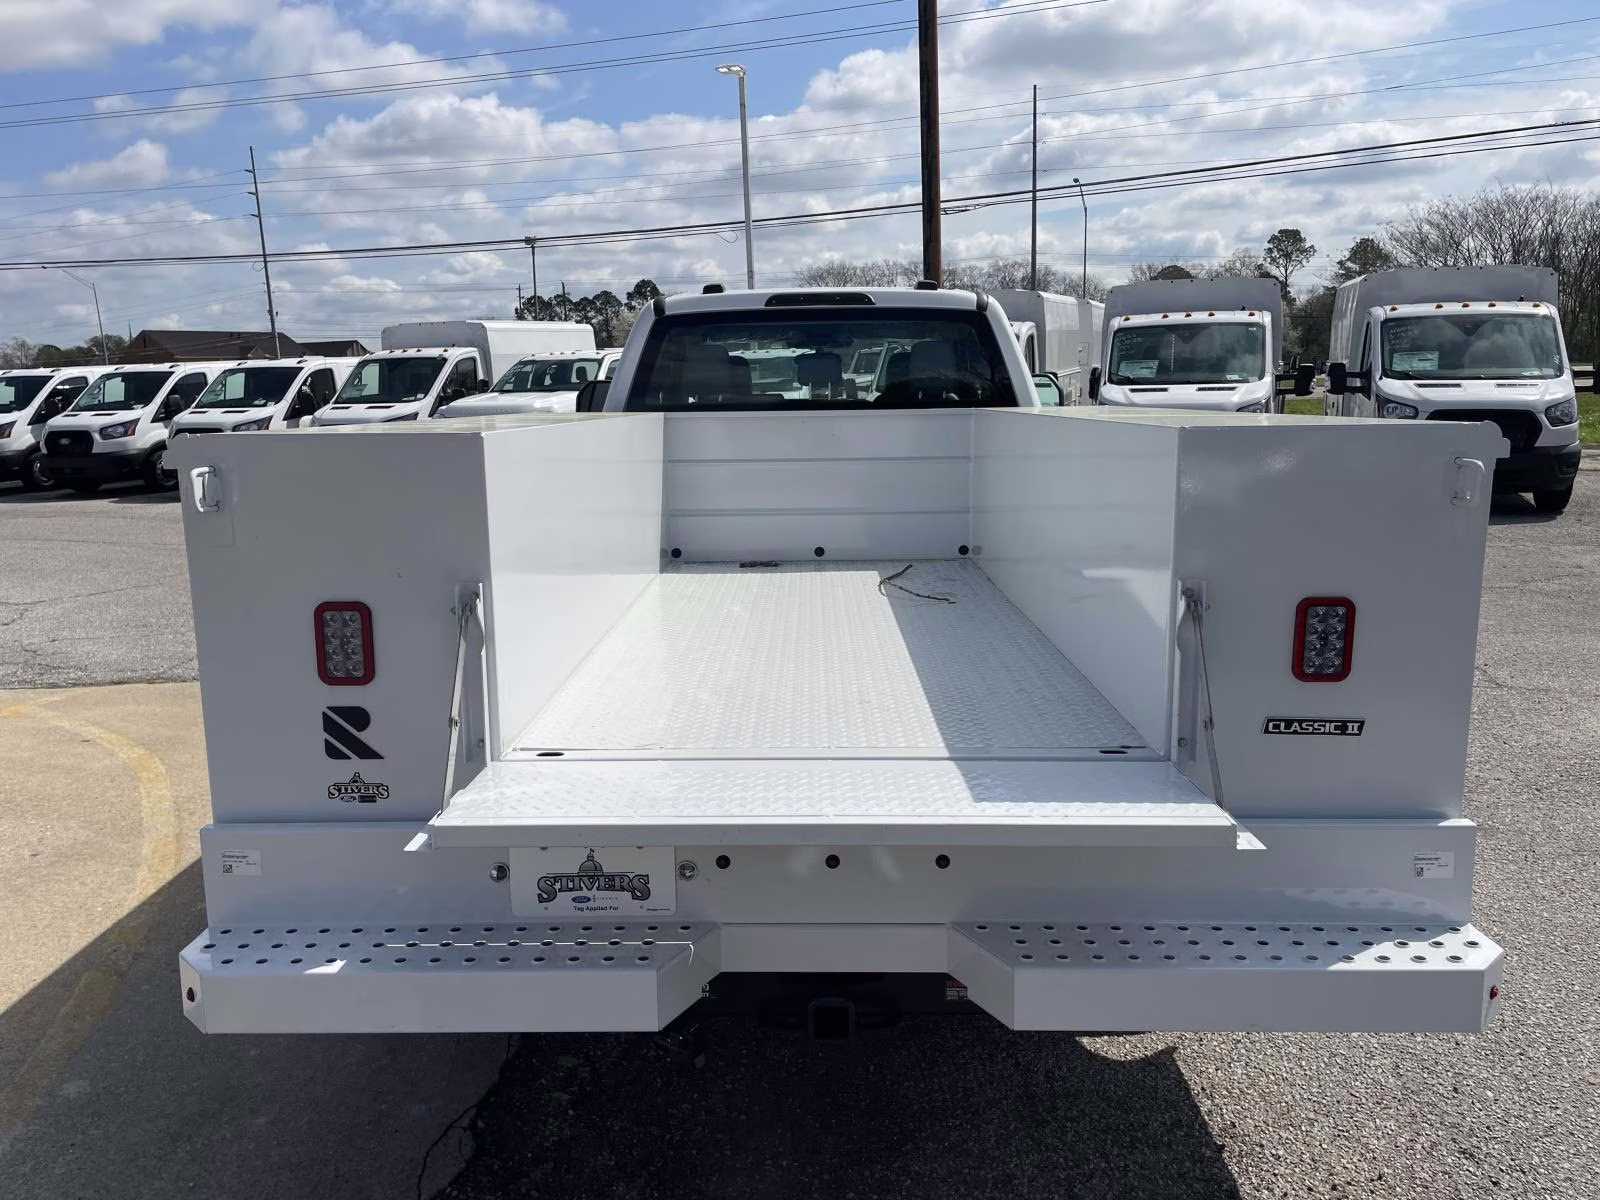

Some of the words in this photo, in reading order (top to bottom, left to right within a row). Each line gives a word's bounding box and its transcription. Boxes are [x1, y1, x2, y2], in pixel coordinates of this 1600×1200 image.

[1268, 721, 1342, 733] CLASSIC
[1345, 722, 1361, 734] II
[328, 784, 389, 799] STIVERS
[537, 874, 650, 903] STIVERS
